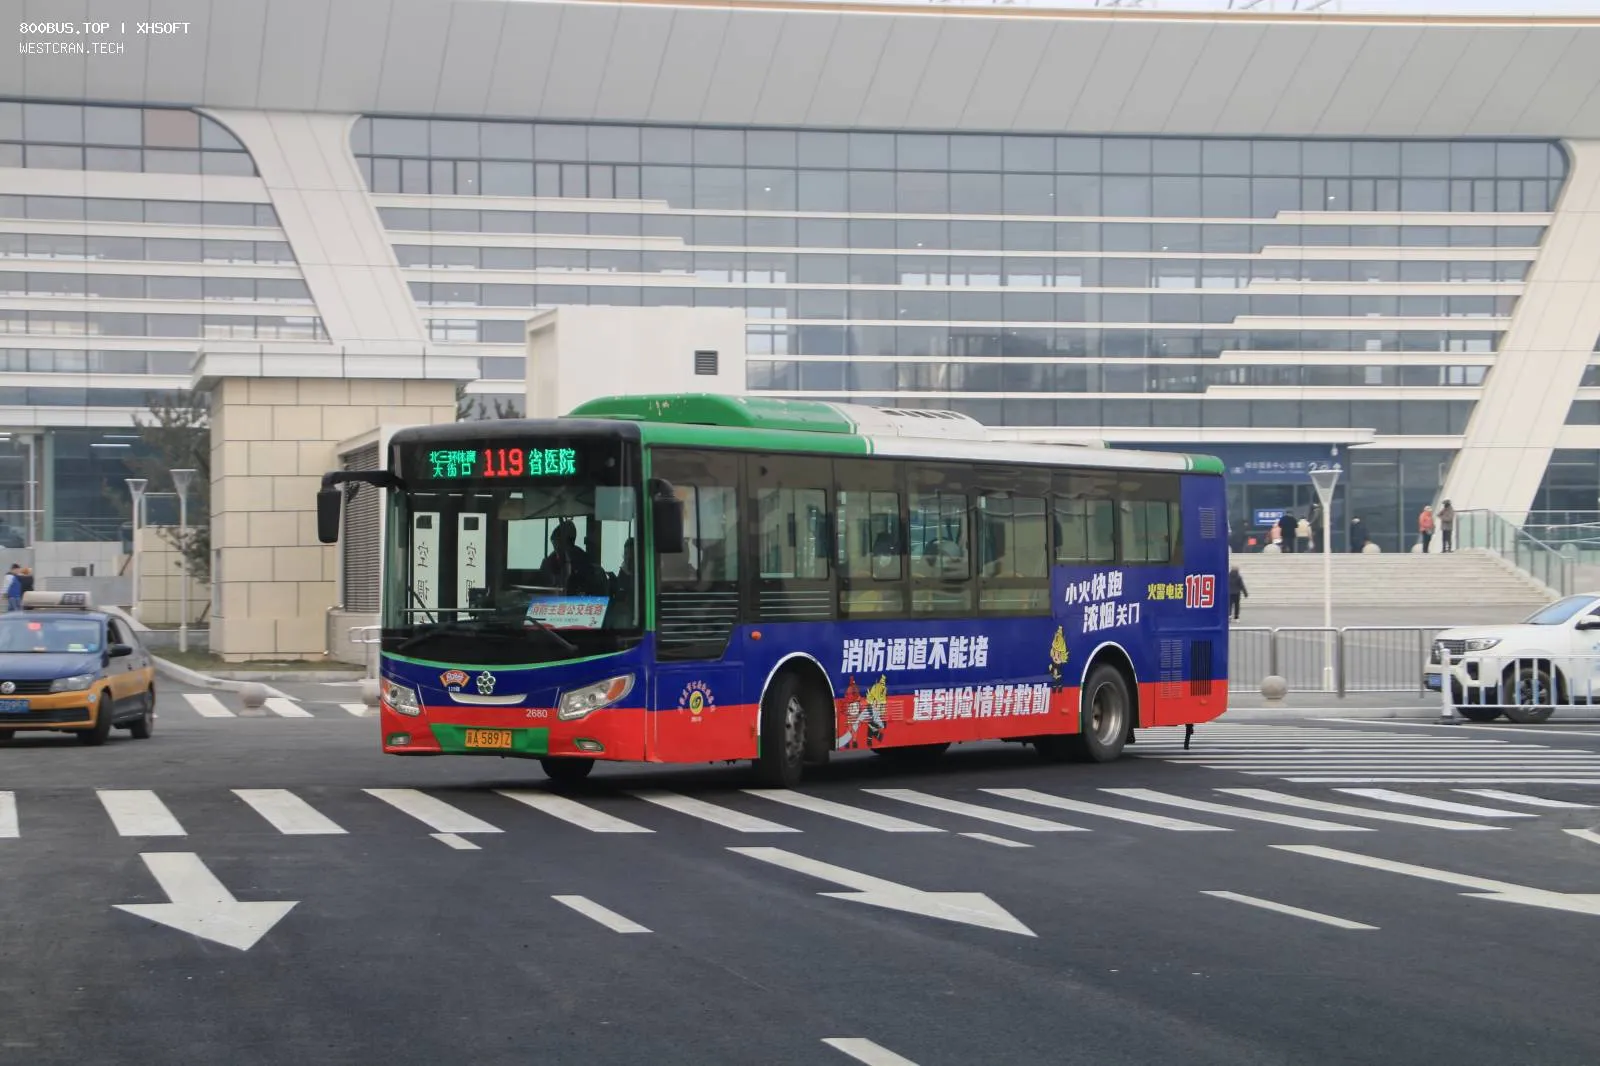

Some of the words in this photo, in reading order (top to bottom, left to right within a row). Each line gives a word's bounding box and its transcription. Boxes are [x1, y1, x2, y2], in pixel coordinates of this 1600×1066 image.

[484, 448, 523, 476] 119
[529, 447, 576, 475] 省医院
[1064, 570, 1123, 605] 小火快跑
[1147, 583, 1184, 600] 火警电话
[1185, 574, 1216, 609] 119
[1082, 601, 1141, 633] 浓烟关门
[841, 635, 989, 673] 消防通道不能堵
[526, 709, 548, 718] 2680
[912, 683, 1051, 721] 遇到险情好救助
